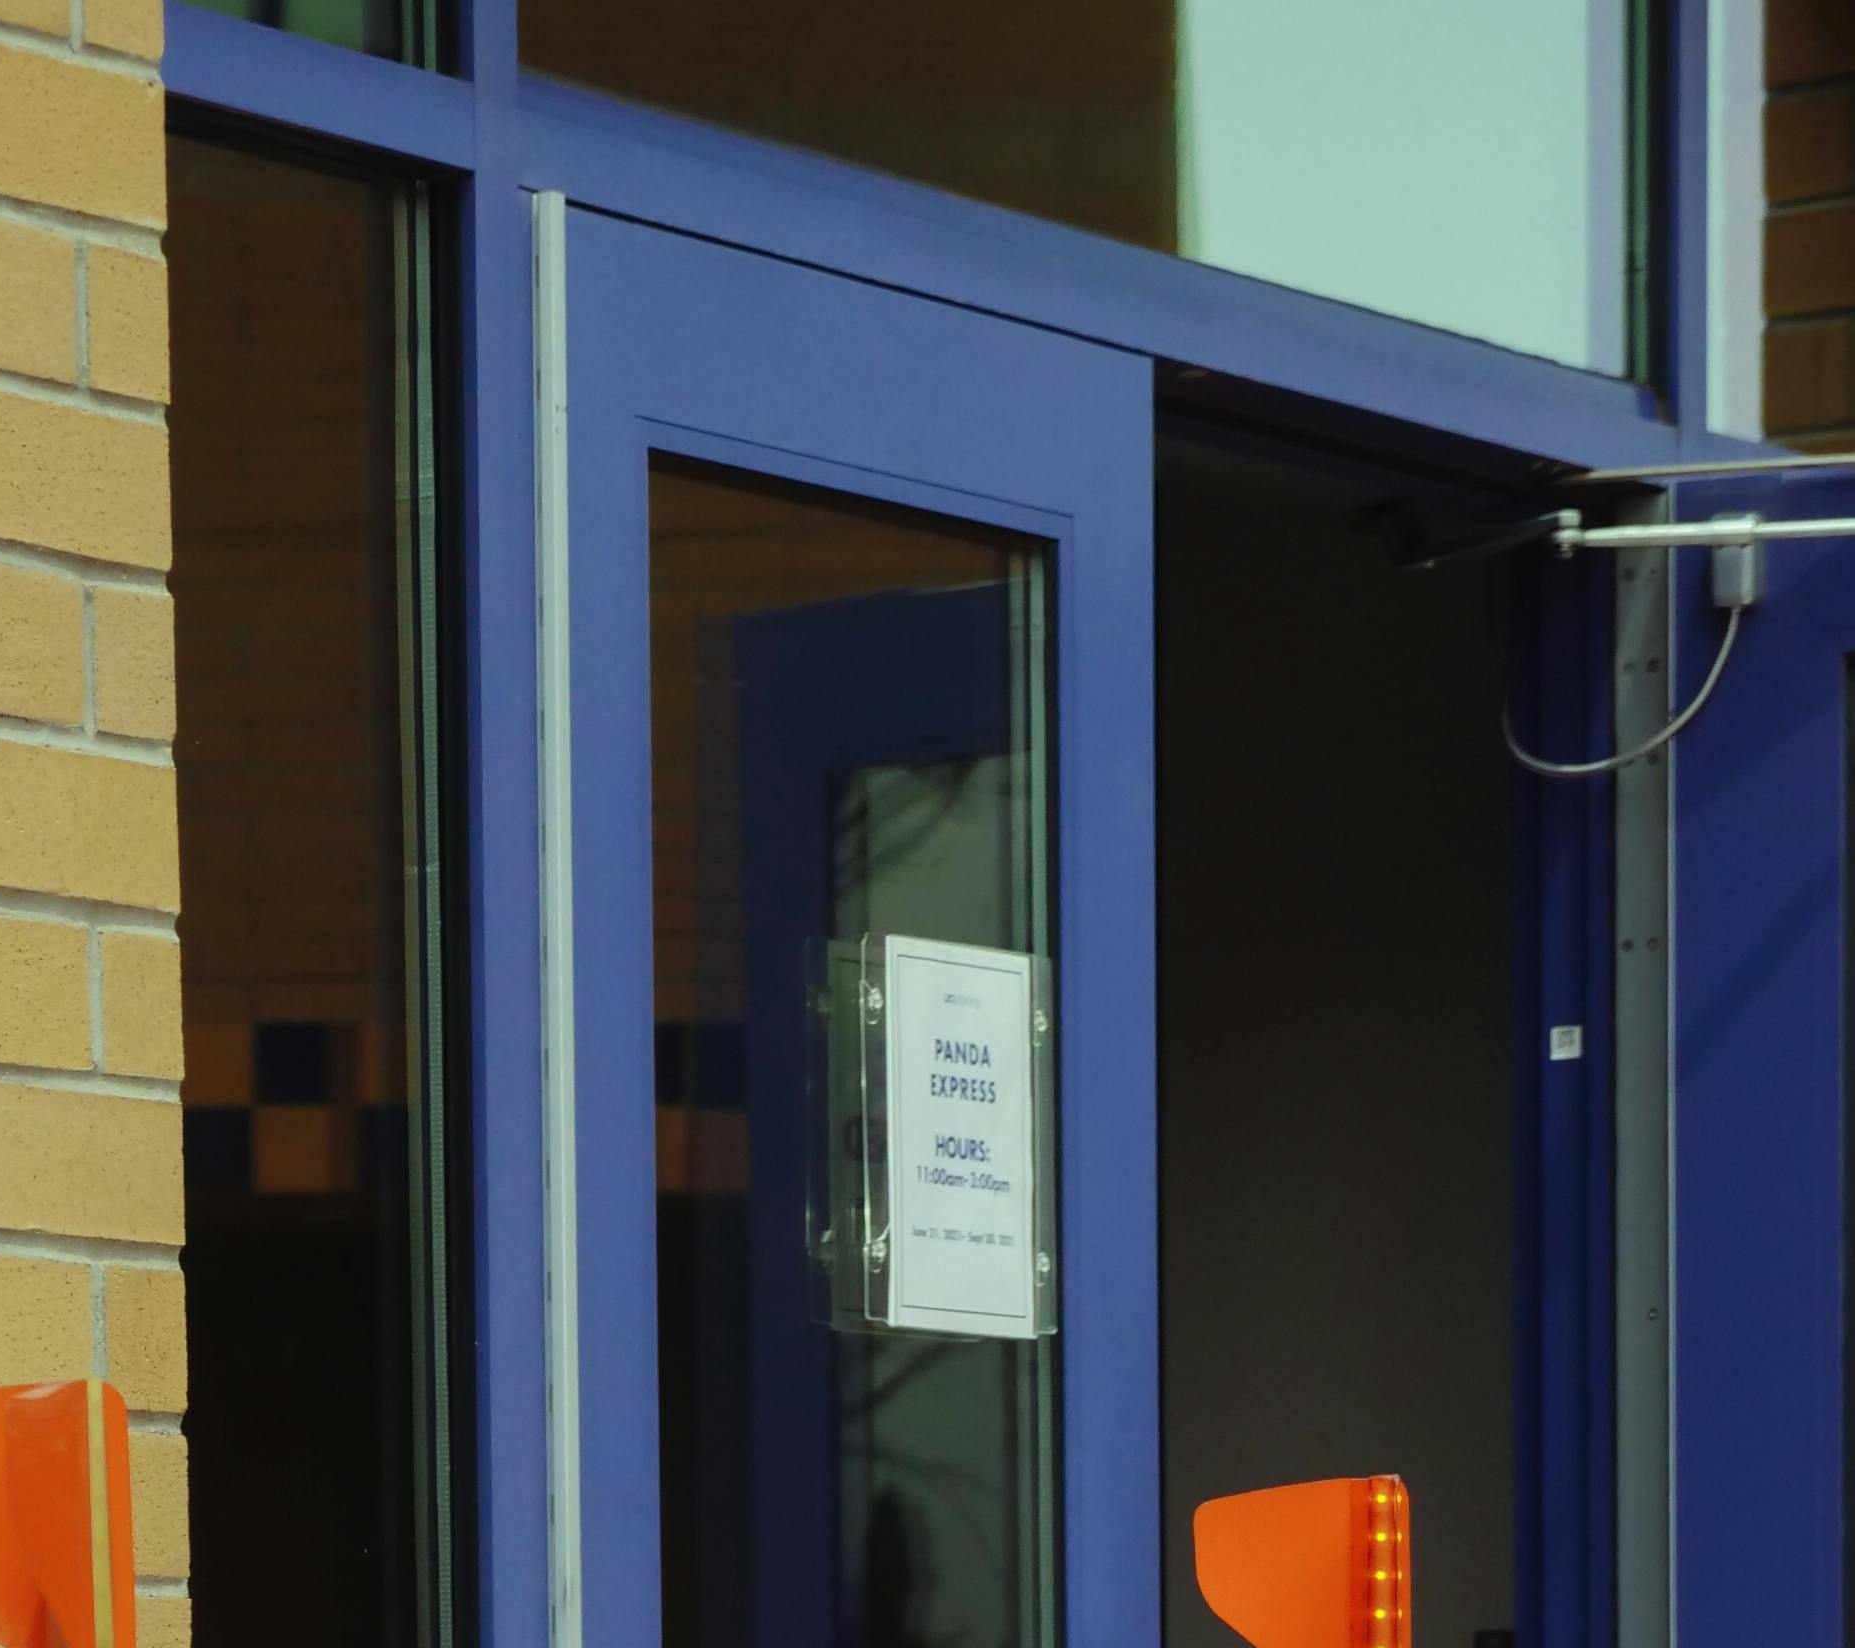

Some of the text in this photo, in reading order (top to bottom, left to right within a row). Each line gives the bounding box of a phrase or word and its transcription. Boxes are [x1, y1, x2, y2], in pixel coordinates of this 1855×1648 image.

[934, 1038, 992, 1069] PANDA
[930, 1073, 997, 1104] EXPRESS
[934, 1134, 991, 1163] HOURS:
